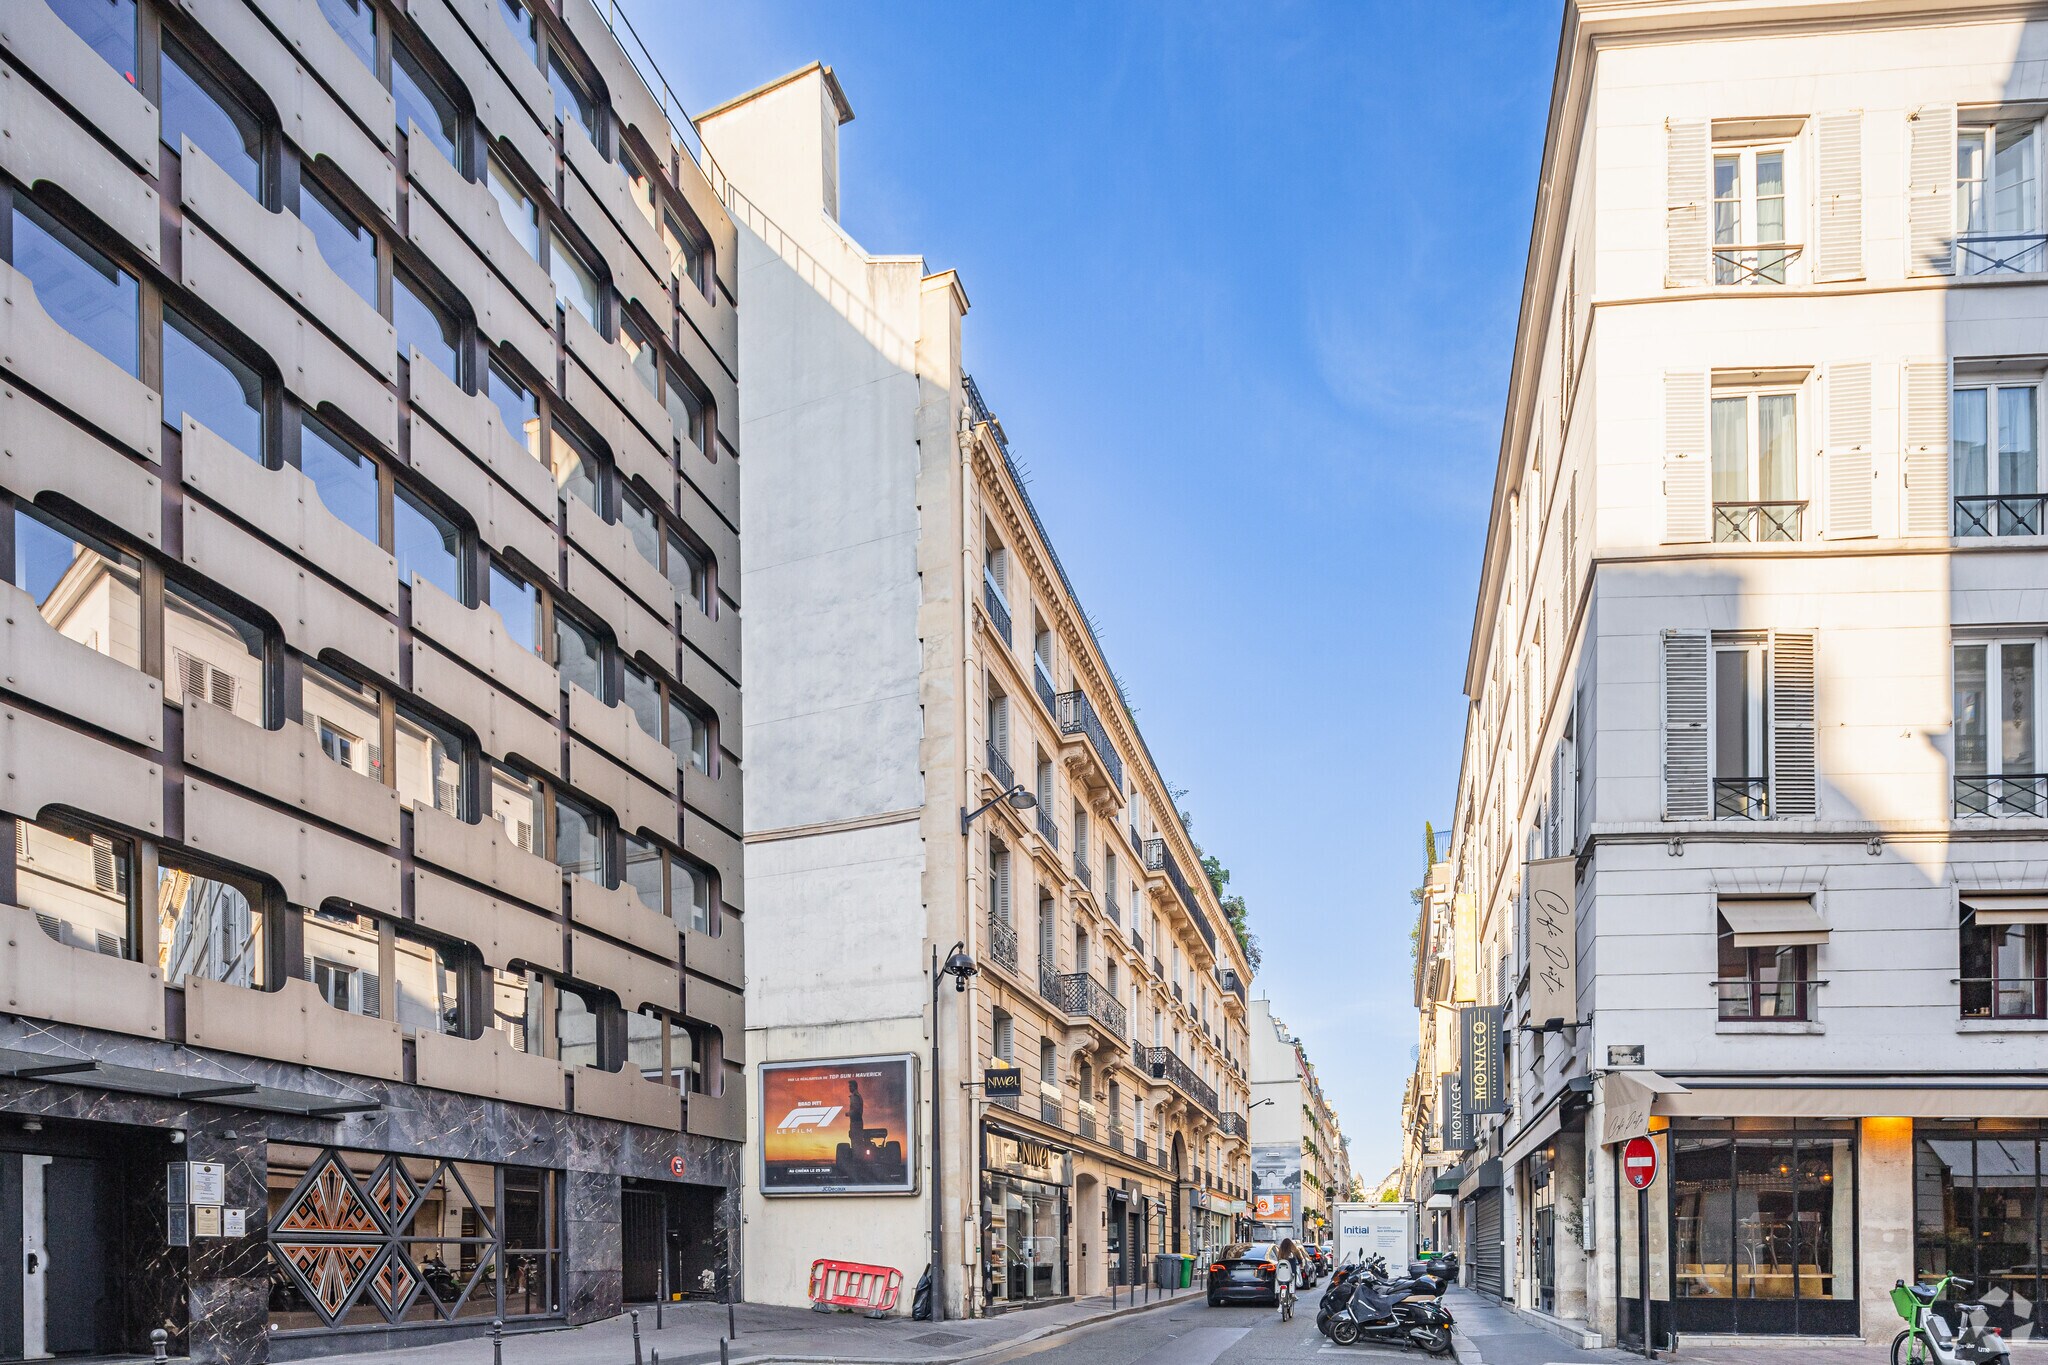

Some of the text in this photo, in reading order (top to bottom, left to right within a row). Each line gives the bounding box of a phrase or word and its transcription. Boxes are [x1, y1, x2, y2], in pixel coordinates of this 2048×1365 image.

[1534, 889, 1569, 938] Café
[1473, 1021, 1487, 1100] MONACO
[1344, 1225, 1370, 1234] Initial
